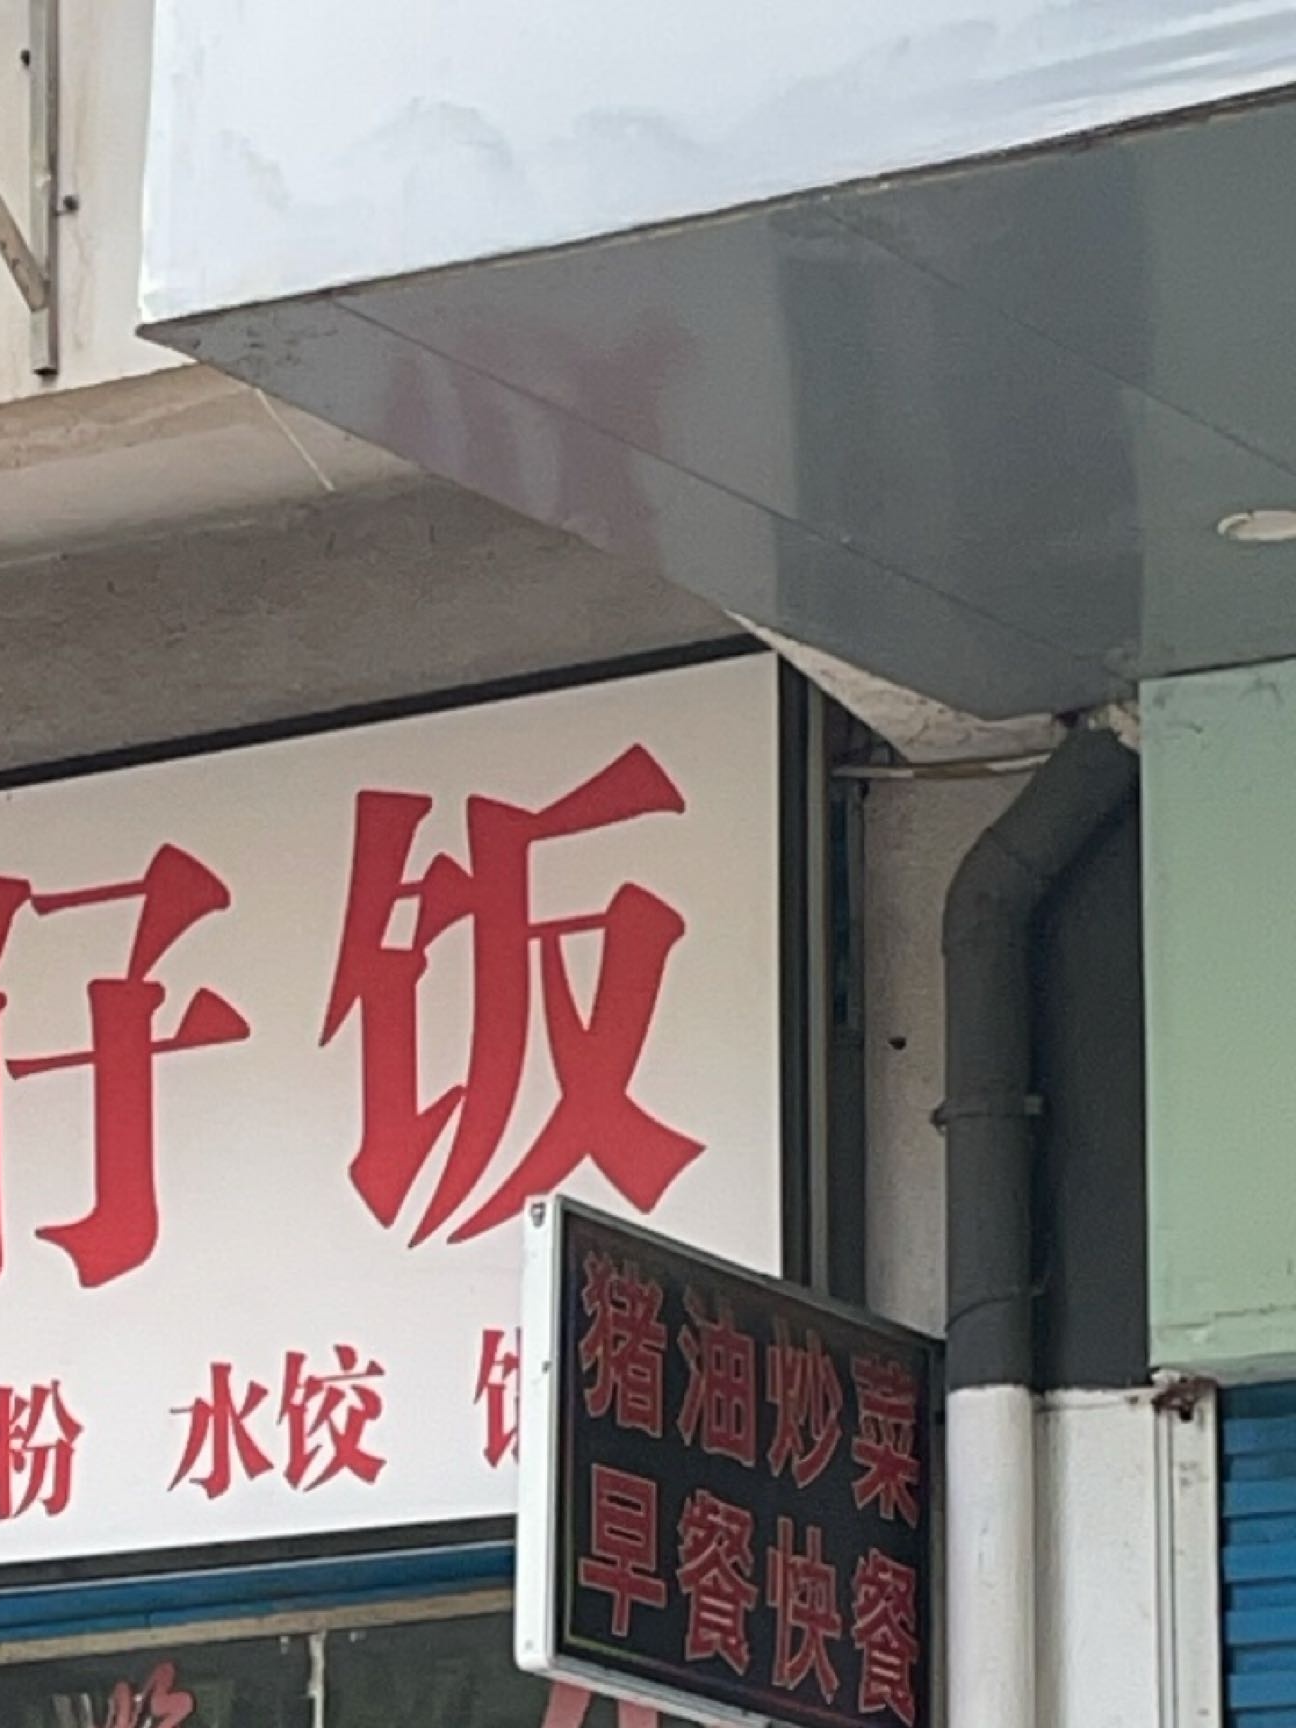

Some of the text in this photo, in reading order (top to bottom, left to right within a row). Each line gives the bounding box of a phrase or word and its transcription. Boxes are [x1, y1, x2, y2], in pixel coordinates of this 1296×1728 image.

[167, 1344, 387, 1499] 水饺
[578, 1250, 920, 1530] 猪油炒菜
[578, 1463, 920, 1728] 早餐快餐
